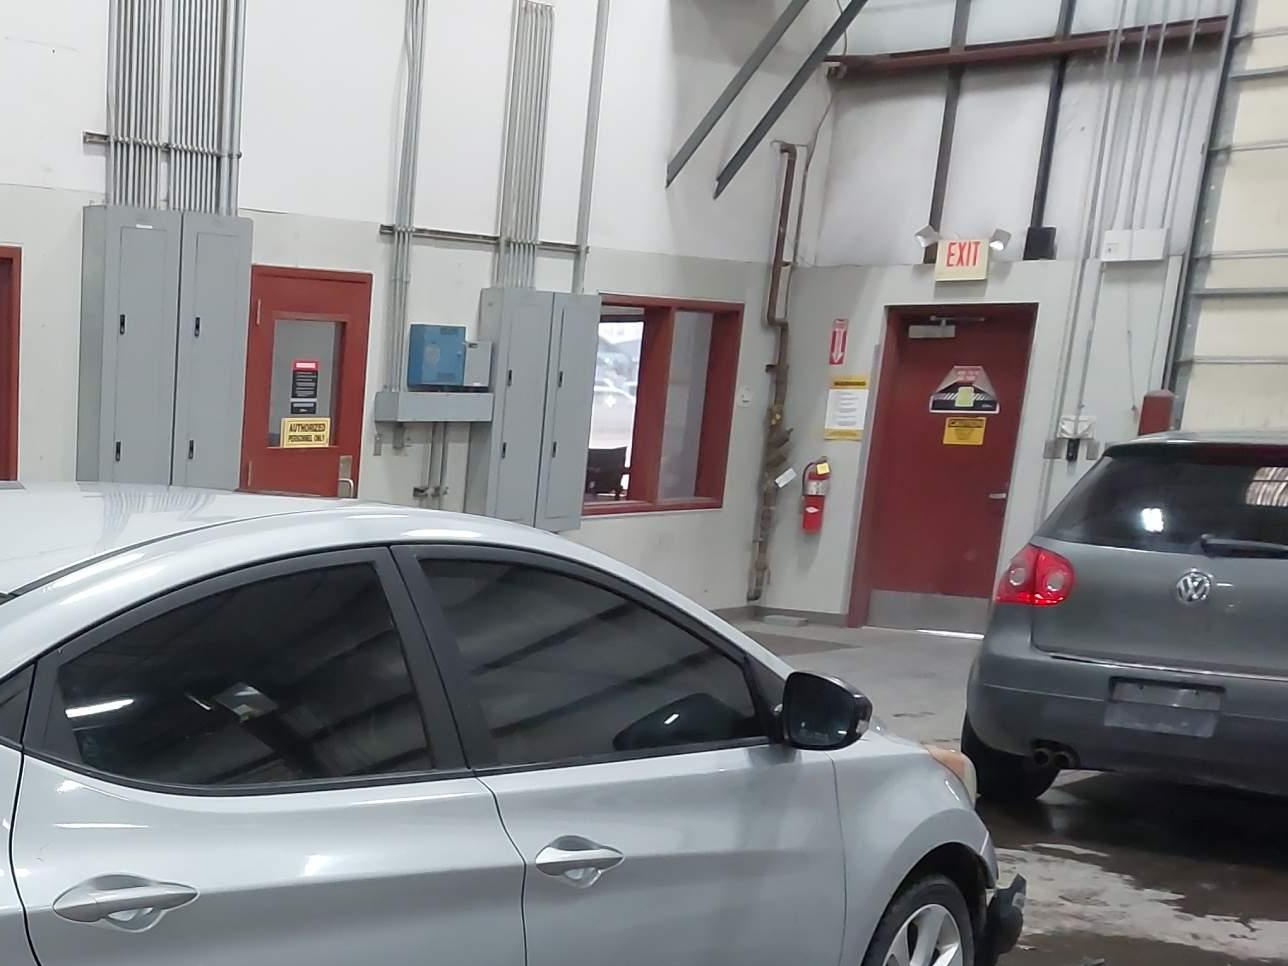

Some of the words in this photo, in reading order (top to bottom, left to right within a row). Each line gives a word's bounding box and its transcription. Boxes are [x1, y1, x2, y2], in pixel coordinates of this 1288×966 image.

[946, 240, 981, 267] EXIT
[288, 423, 326, 433] AUTHORIZED
[313, 434, 325, 442] ONLY
